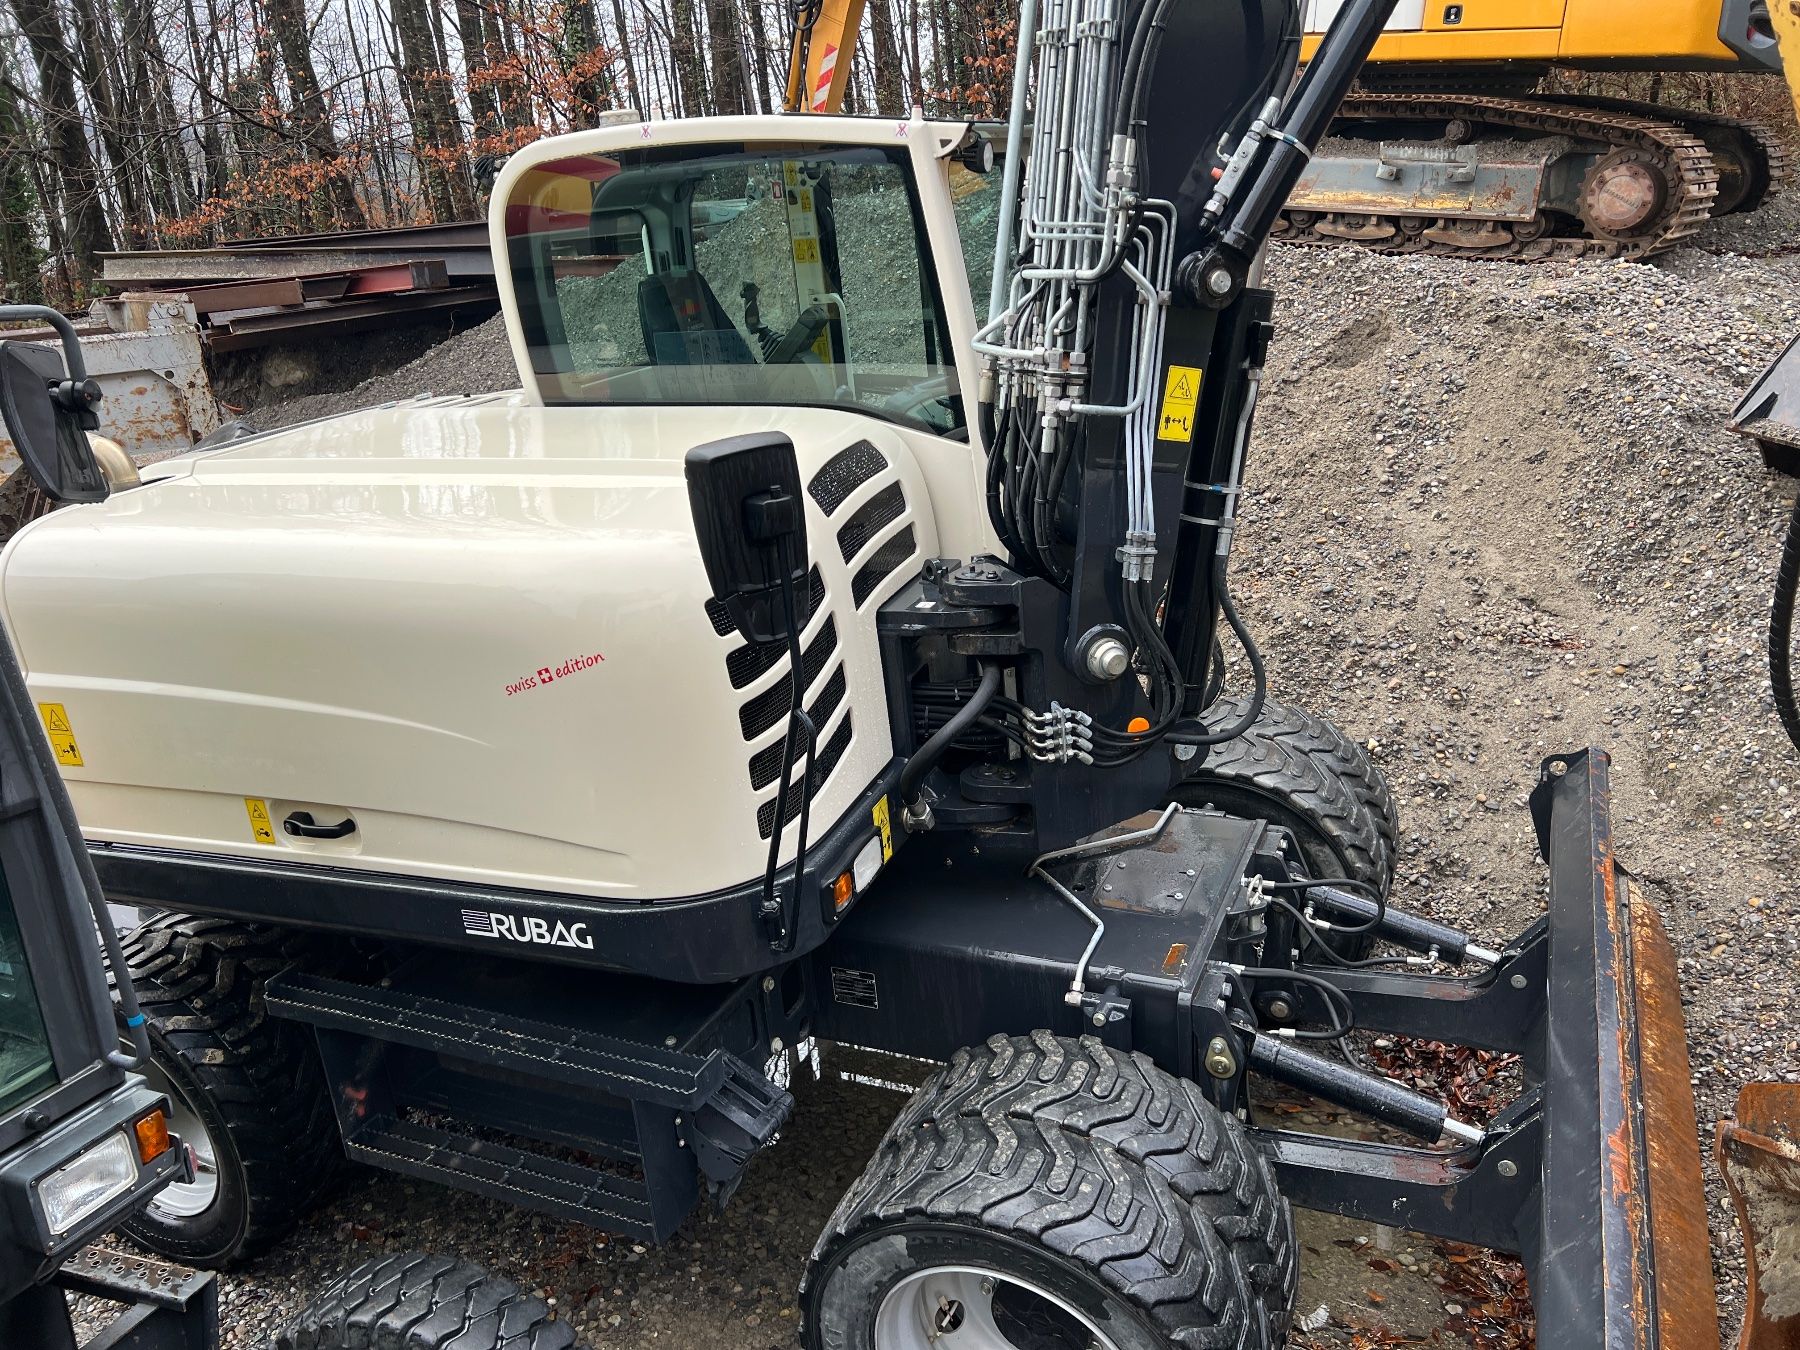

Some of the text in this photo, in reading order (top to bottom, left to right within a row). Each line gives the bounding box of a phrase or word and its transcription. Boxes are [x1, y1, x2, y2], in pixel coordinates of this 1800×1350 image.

[505, 653, 605, 696] swiss edition
[489, 912, 594, 949] RUBAG
